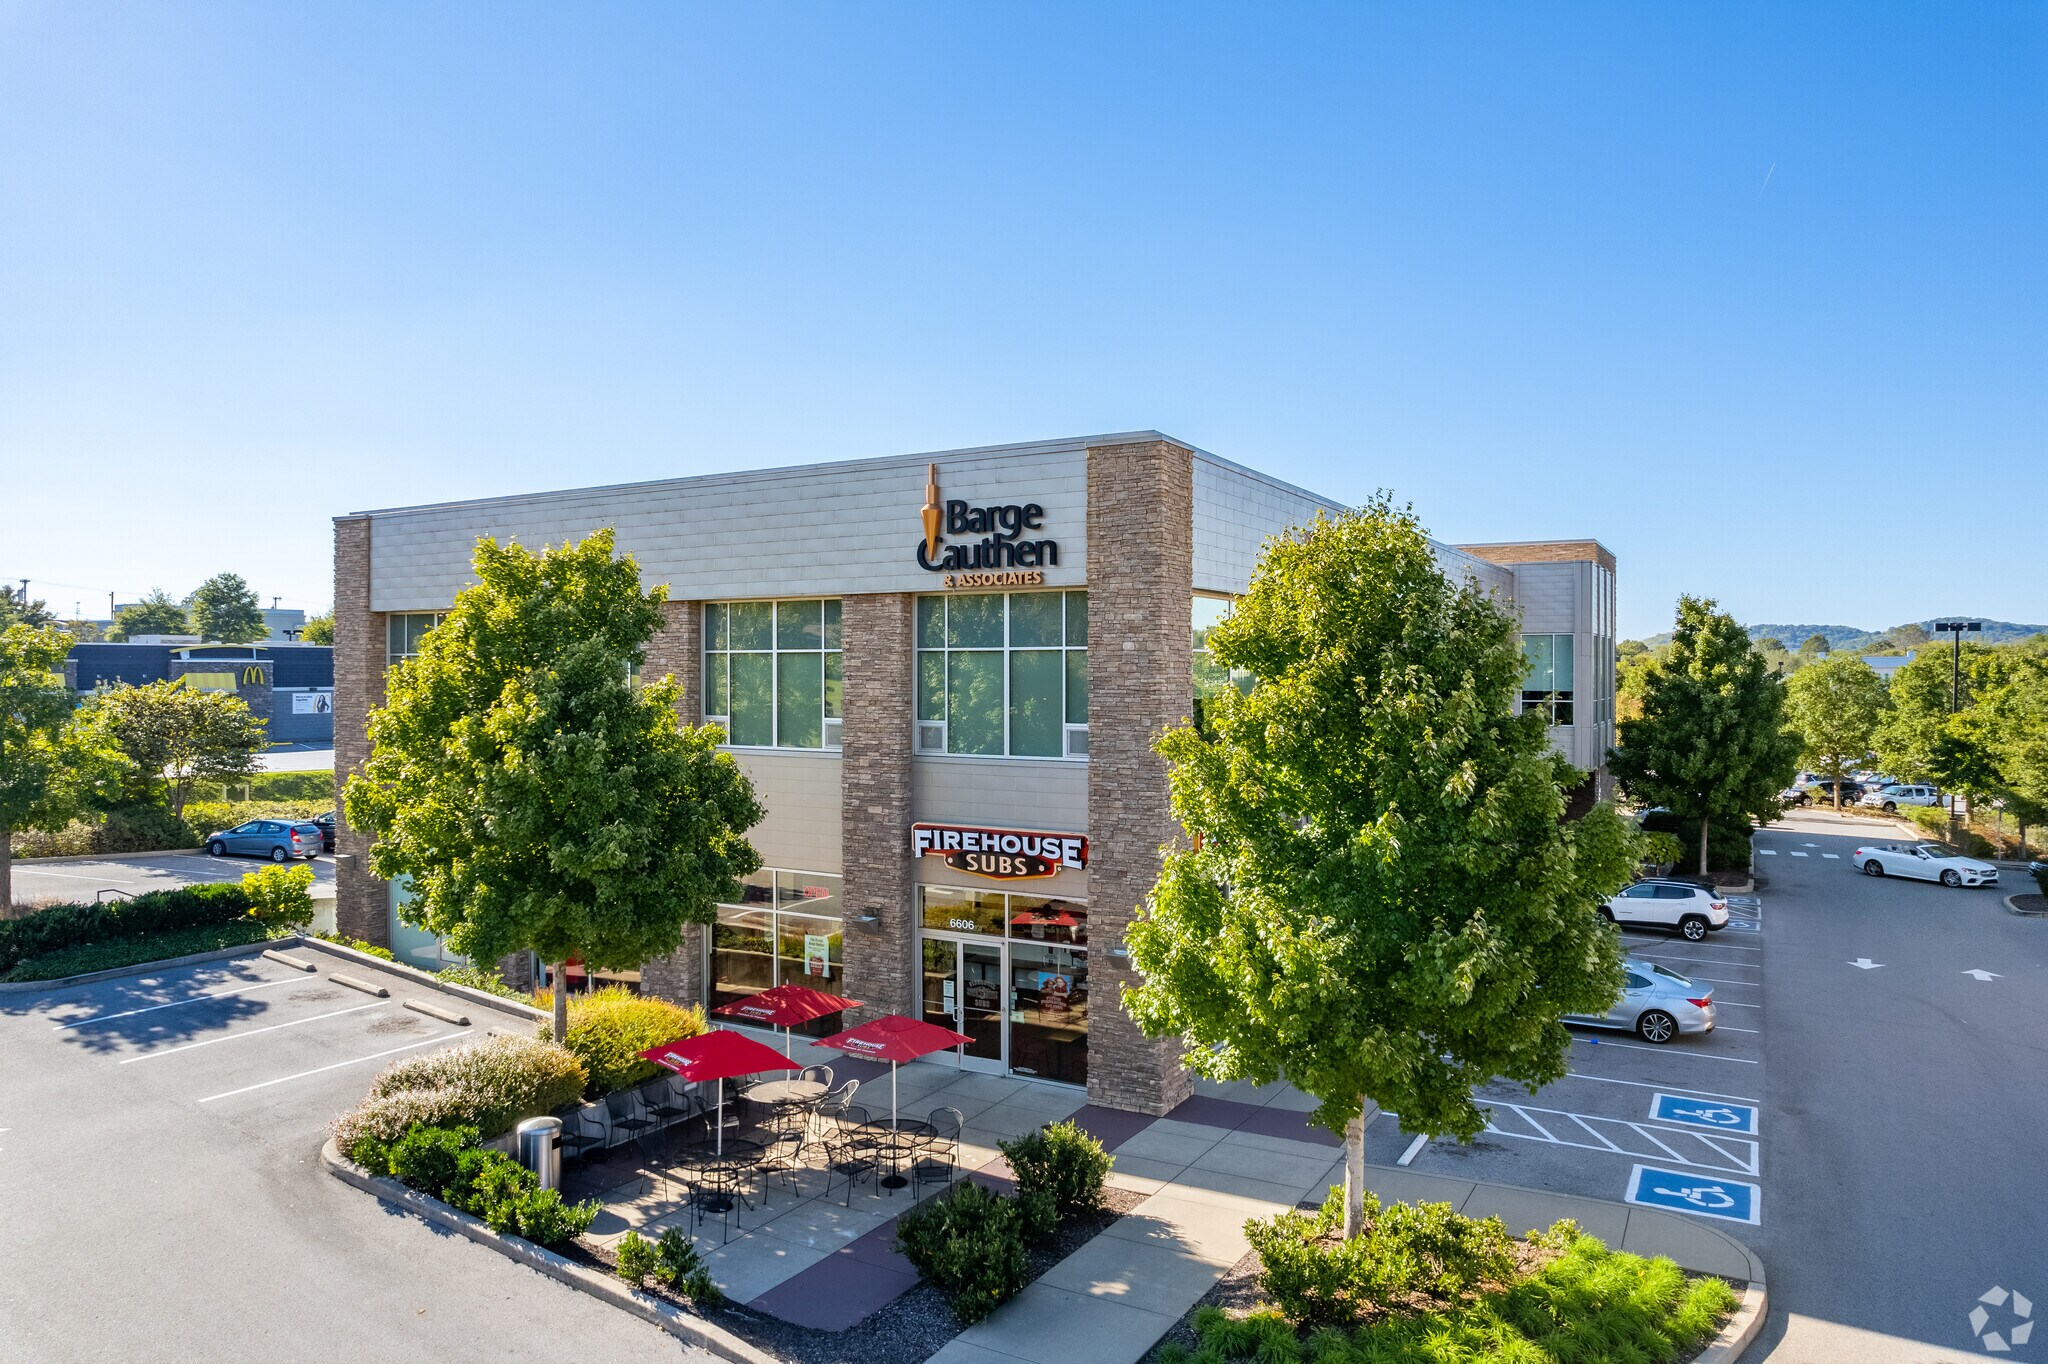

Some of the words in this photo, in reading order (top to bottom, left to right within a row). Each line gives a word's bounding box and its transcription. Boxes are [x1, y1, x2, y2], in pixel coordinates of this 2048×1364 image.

[947, 500, 1044, 540] Barge
[917, 533, 1057, 571] Cauthen
[943, 575, 953, 587] &
[957, 571, 1042, 587] ASSOCIATES
[914, 829, 1082, 870] FIREHOUSE
[966, 854, 1027, 875] SUBS
[804, 886, 829, 898] OPEN
[950, 919, 974, 930] 6606
